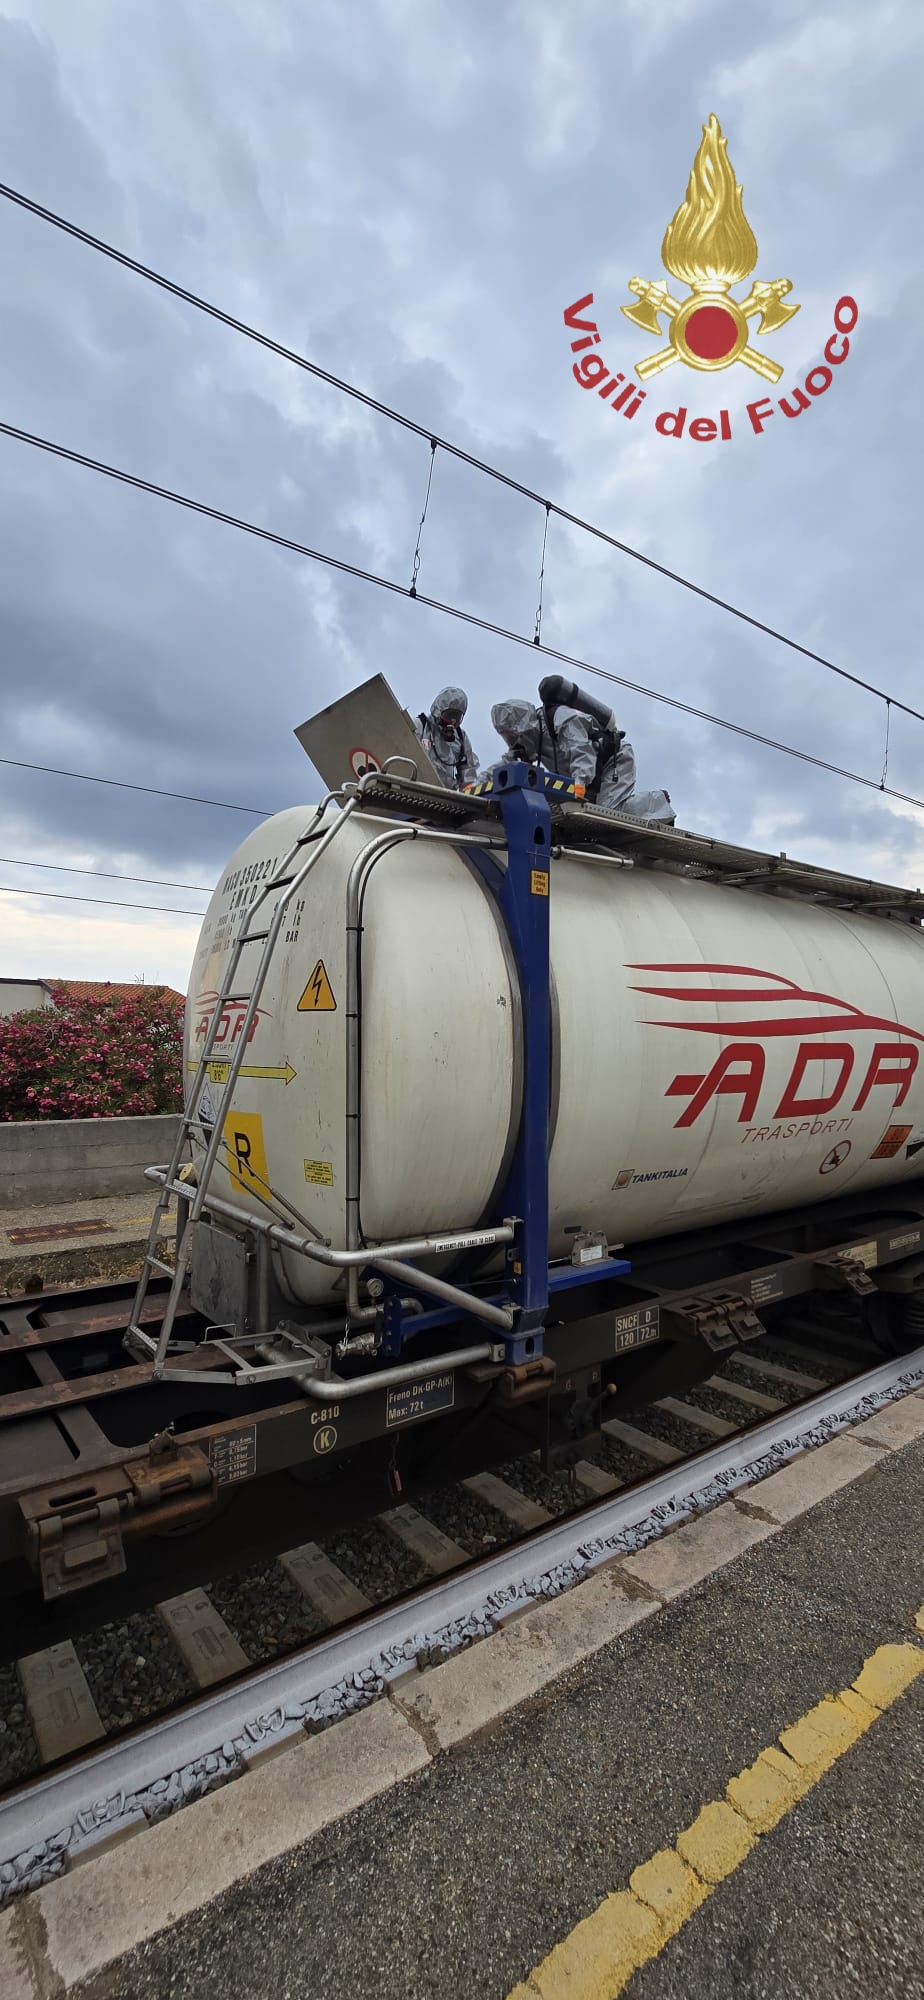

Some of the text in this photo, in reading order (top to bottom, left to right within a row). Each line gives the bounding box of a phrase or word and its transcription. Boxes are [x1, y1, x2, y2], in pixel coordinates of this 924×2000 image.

[285, 930, 299, 943] BAR
[663, 1042, 920, 1129] ADR
[741, 1118, 854, 1144] TRASPORTI
[234, 1131, 256, 1177] R
[632, 1168, 688, 1184] TANKITALIA
[617, 1311, 651, 1332] SNCF D
[620, 1332, 634, 1348] 120
[389, 1391, 410, 1404] Freno
[311, 1405, 339, 1425] C-810
[388, 1407, 408, 1420] Max:
[320, 1430, 330, 1449] K
